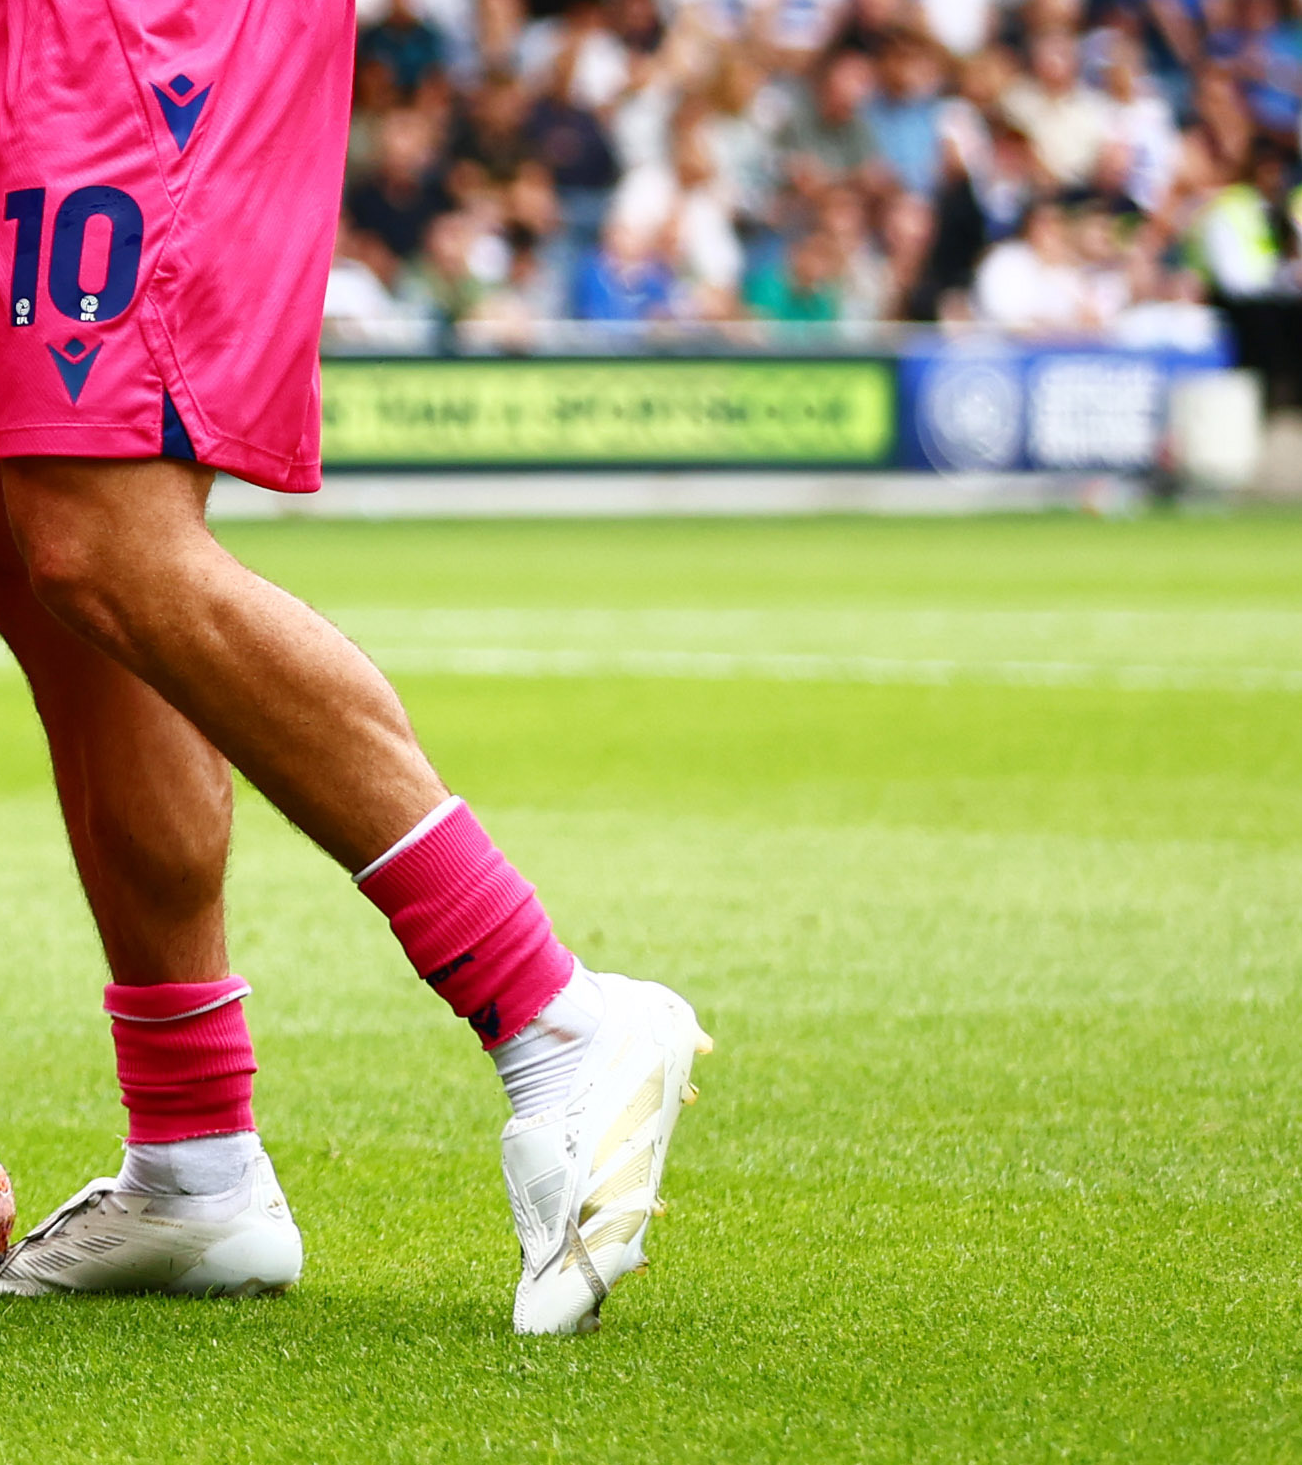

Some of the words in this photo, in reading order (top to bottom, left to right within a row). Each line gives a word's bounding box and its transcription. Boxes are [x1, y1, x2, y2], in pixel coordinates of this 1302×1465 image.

[4, 184, 145, 327] 10
[15, 316, 30, 325] EFL
[79, 312, 97, 322] EFL
